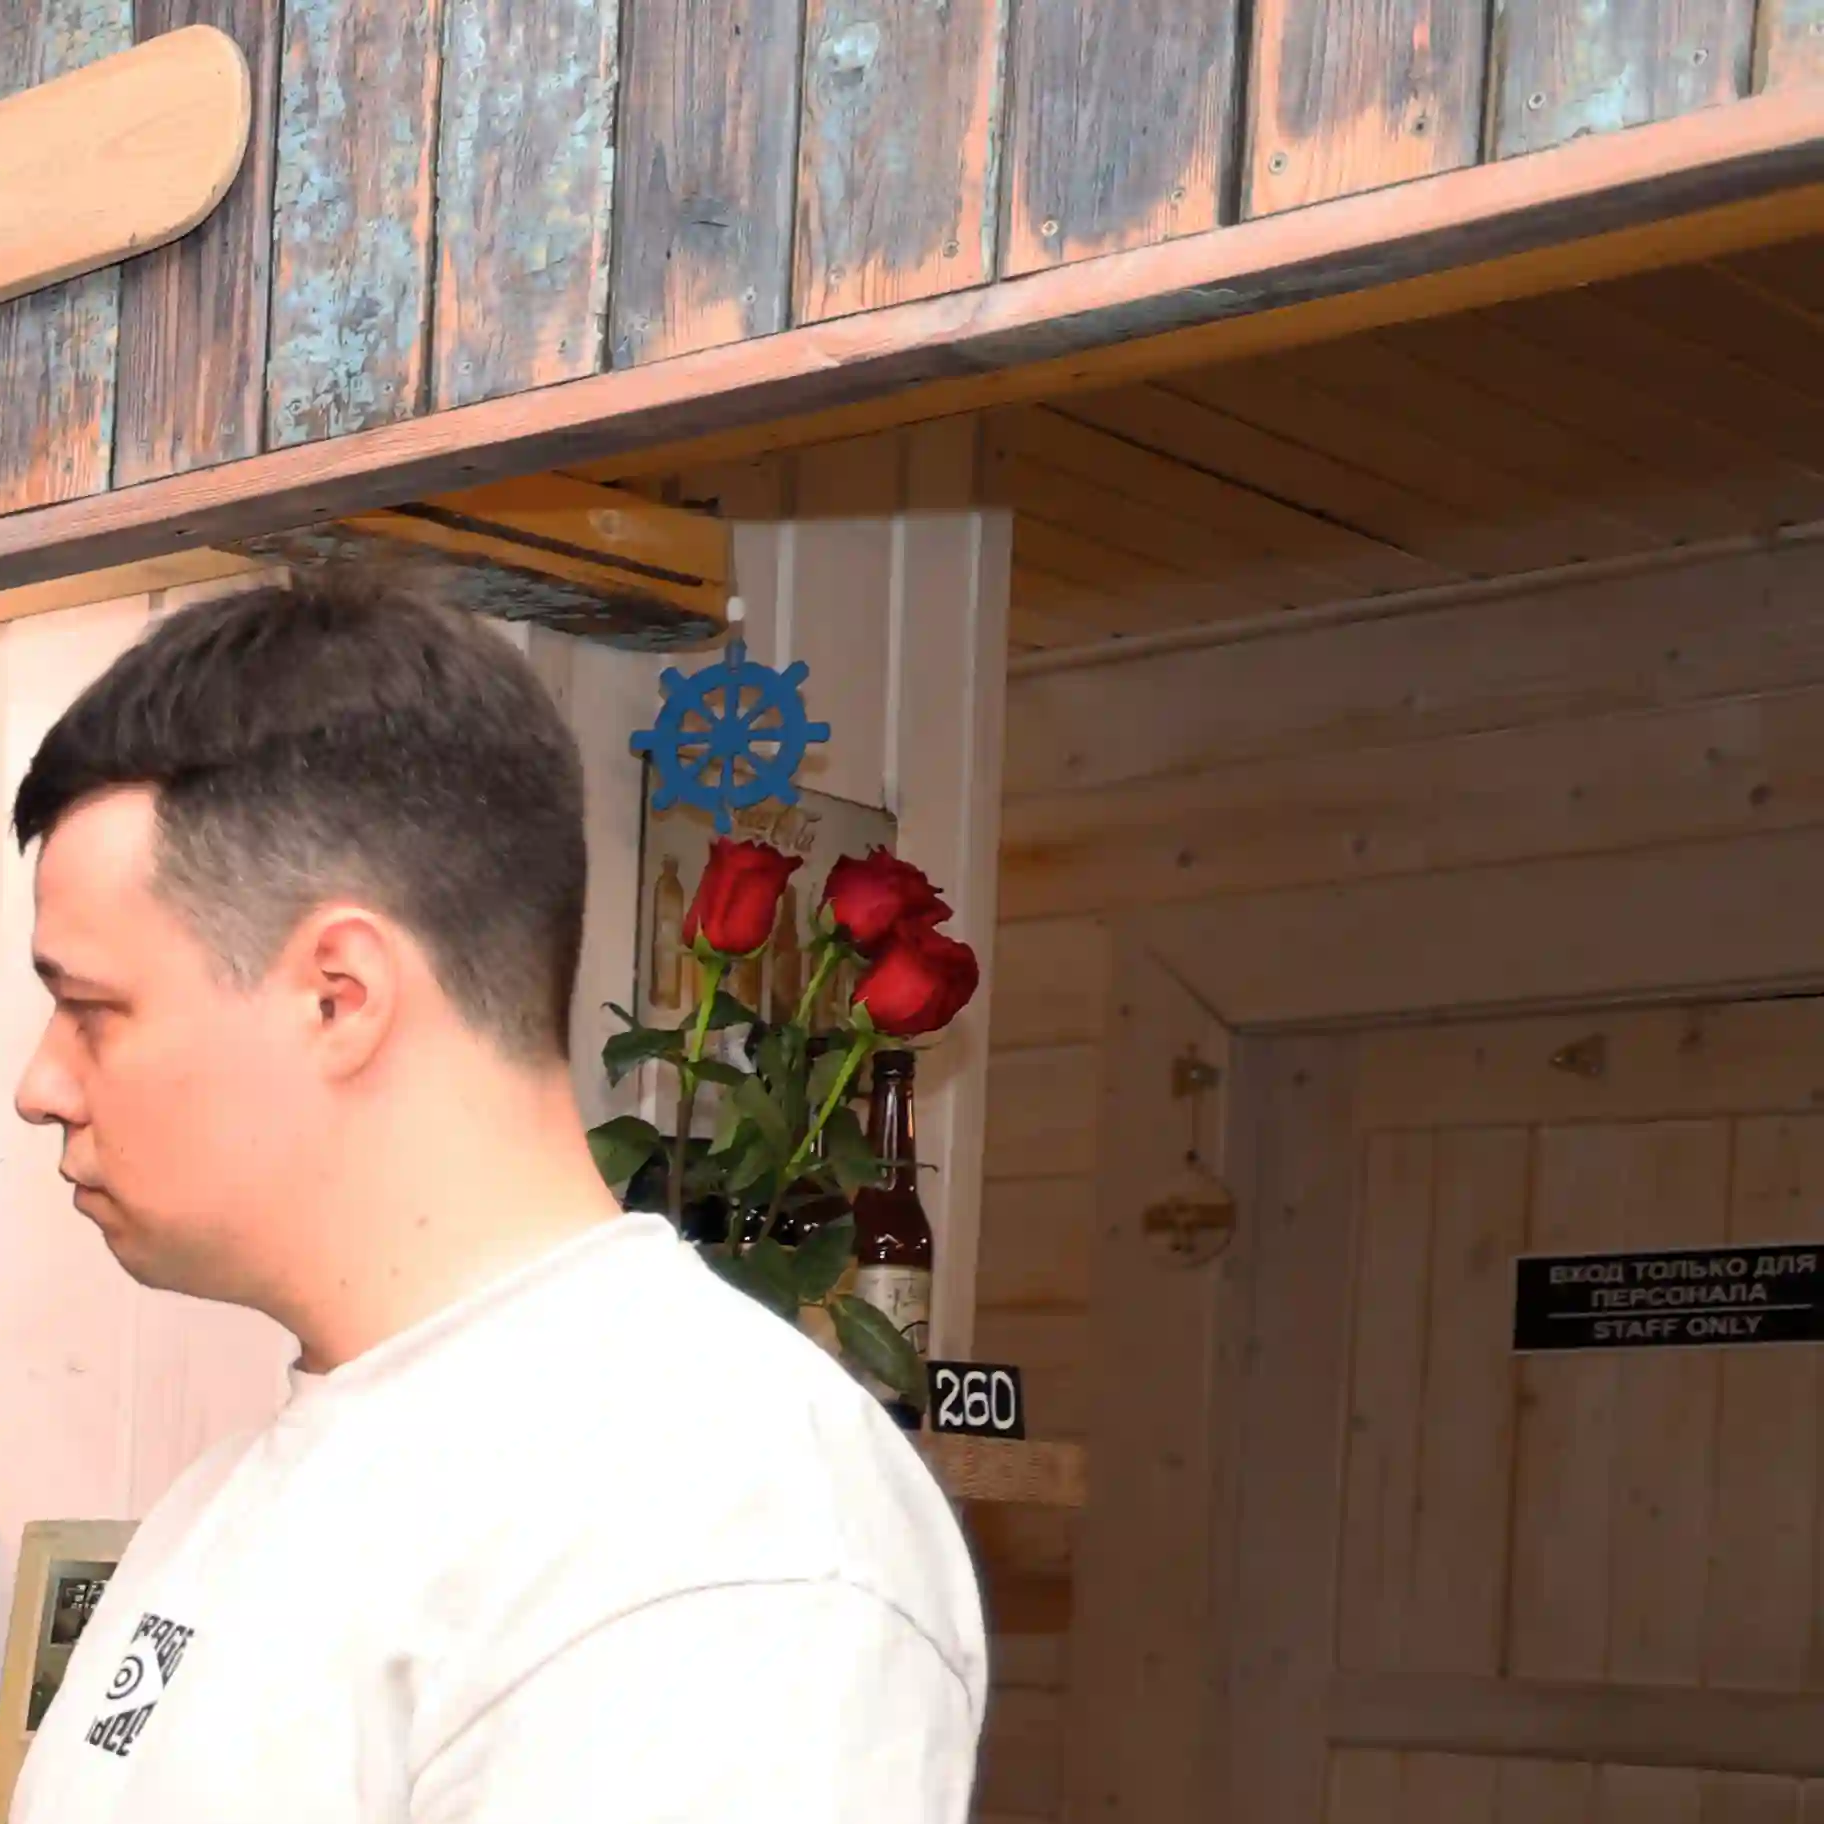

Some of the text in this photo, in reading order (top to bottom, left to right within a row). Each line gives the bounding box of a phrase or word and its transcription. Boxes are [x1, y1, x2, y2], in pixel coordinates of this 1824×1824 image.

[1549, 1254, 1817, 1285] ВХОД ТОЛЬКО ДЛЯ
[1591, 1283, 1767, 1308] ПЕРСОНАЛА
[1594, 1315, 1763, 1340] STAFF ONLY
[936, 1368, 1016, 1430] 260
